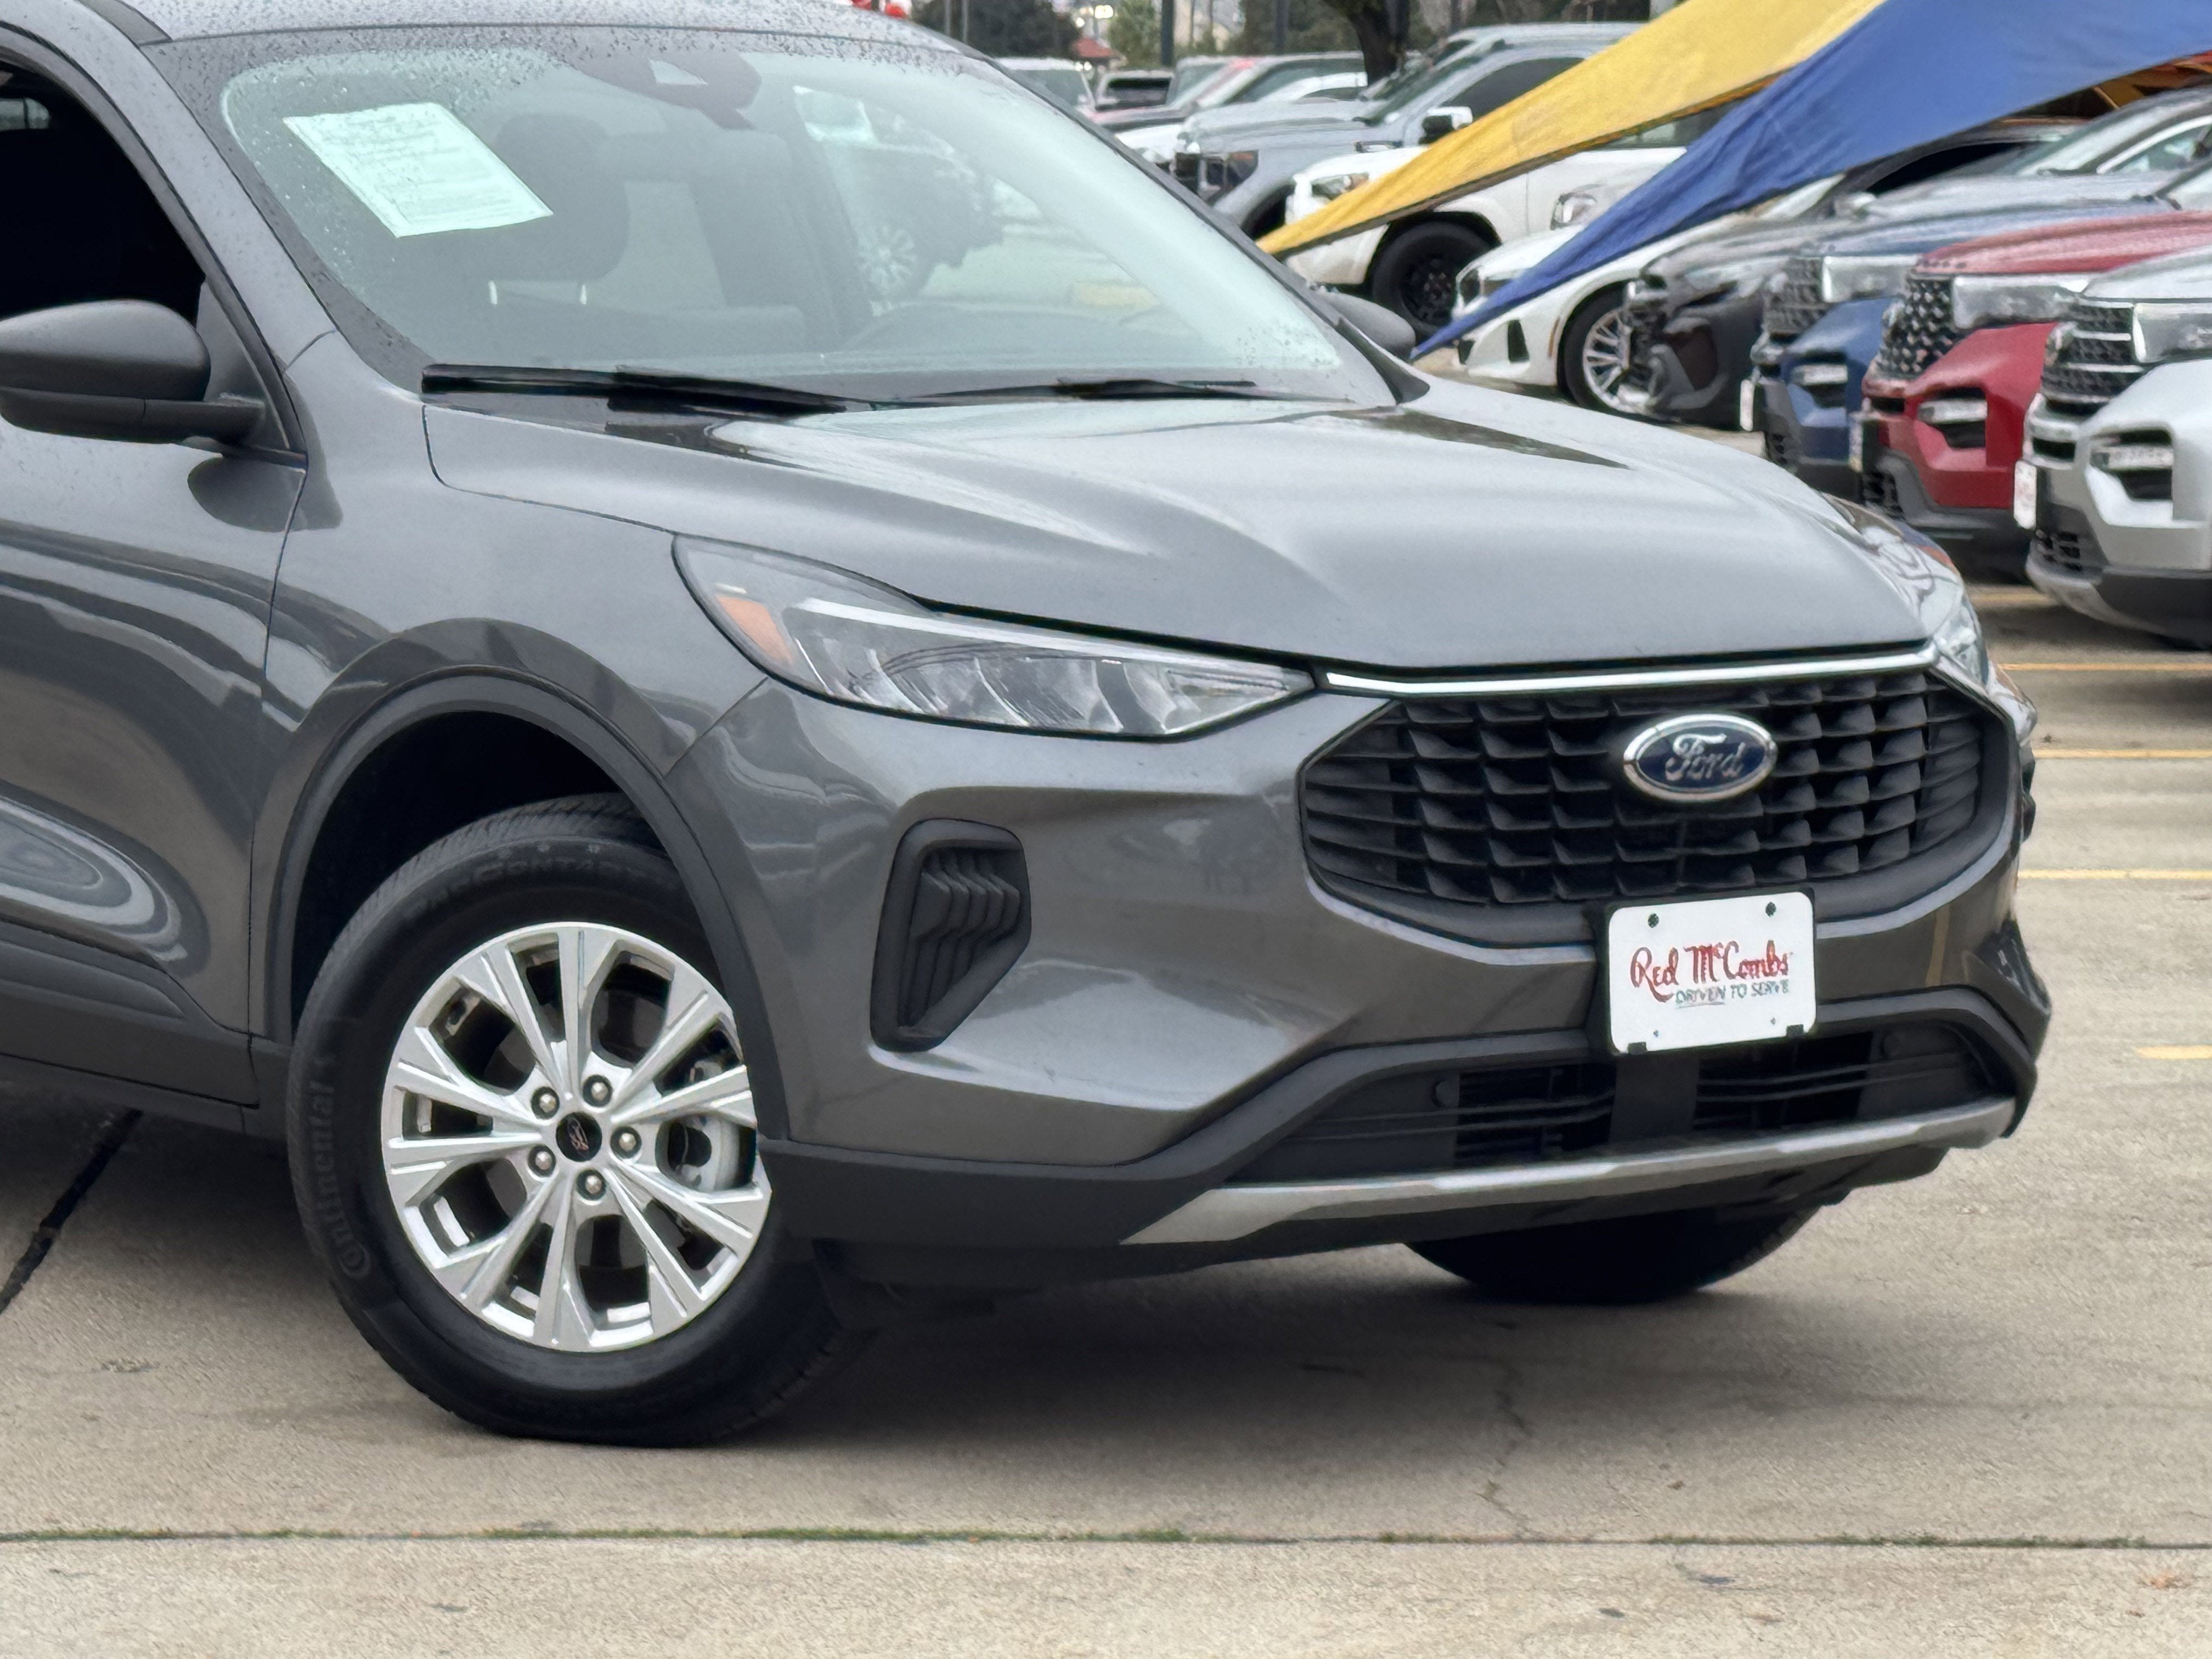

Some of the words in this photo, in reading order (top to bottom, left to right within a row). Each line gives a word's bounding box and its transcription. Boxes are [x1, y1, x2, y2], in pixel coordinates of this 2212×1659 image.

[1664, 732, 1745, 781] Ford
[1630, 946, 1679, 1003] Red
[1683, 940, 1790, 984] McCombs
[1675, 985, 1726, 1004] DRIVEN
[1730, 983, 1747, 999] TO
[1751, 979, 1789, 997] SERVE
[308, 1080, 371, 1279] Continental
